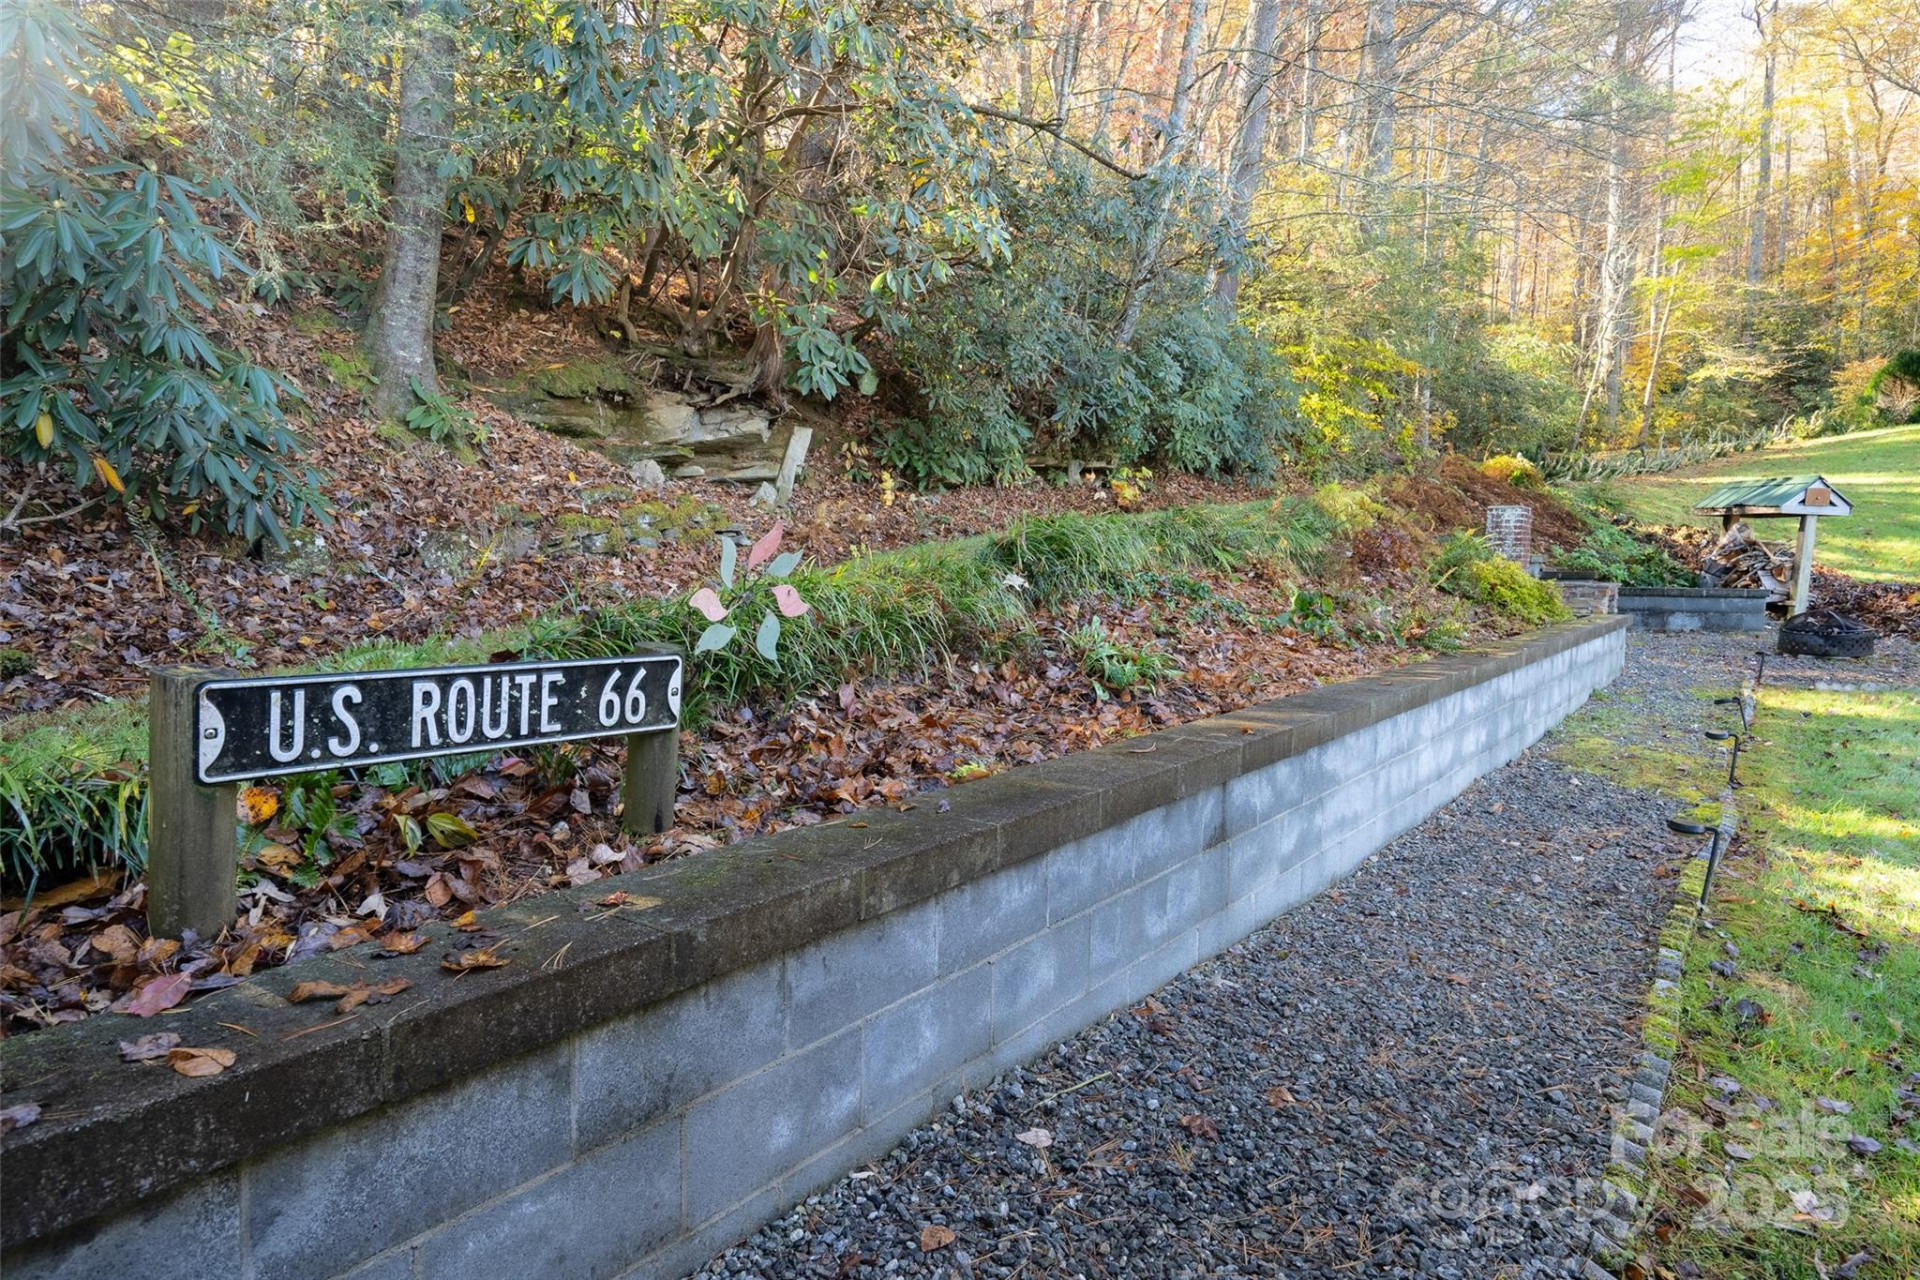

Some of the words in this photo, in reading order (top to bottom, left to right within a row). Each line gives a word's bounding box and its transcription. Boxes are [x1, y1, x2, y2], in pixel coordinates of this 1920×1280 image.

[269, 685, 379, 762] U.S.
[411, 671, 565, 748] ROUTE
[599, 667, 647, 727] 66
